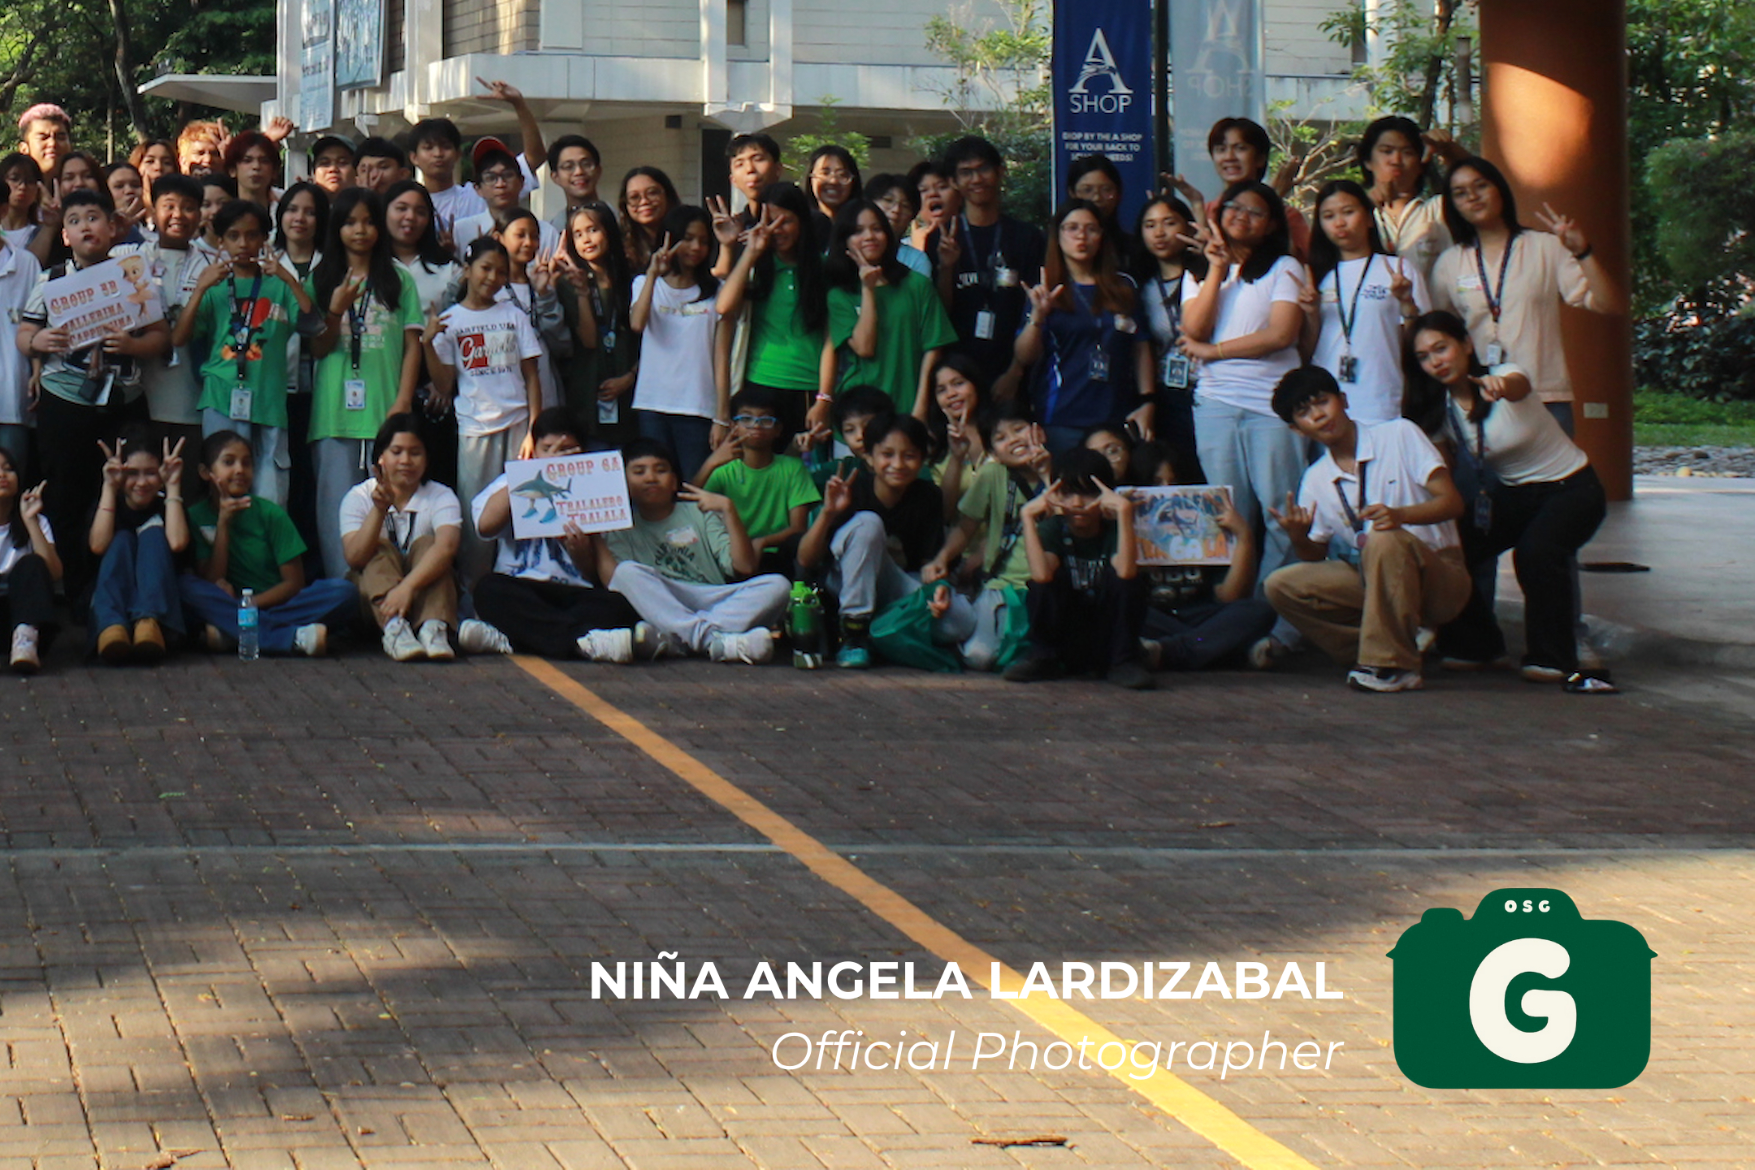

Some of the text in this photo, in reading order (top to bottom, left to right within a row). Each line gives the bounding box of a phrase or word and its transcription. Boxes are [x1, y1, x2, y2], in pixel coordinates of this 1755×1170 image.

[1069, 94, 1132, 113] SHOP
[1084, 132, 1095, 140] BY
[1097, 132, 1111, 140] THE
[1111, 133, 1120, 141] A
[1121, 133, 1143, 141] SHOP
[1065, 142, 1141, 152] FOR YOUR BACK TO
[50, 287, 94, 315] GROUP
[546, 456, 621, 481] GROUP 6A
[556, 495, 623, 515] TRALALERO
[566, 508, 628, 525] TRALALA
